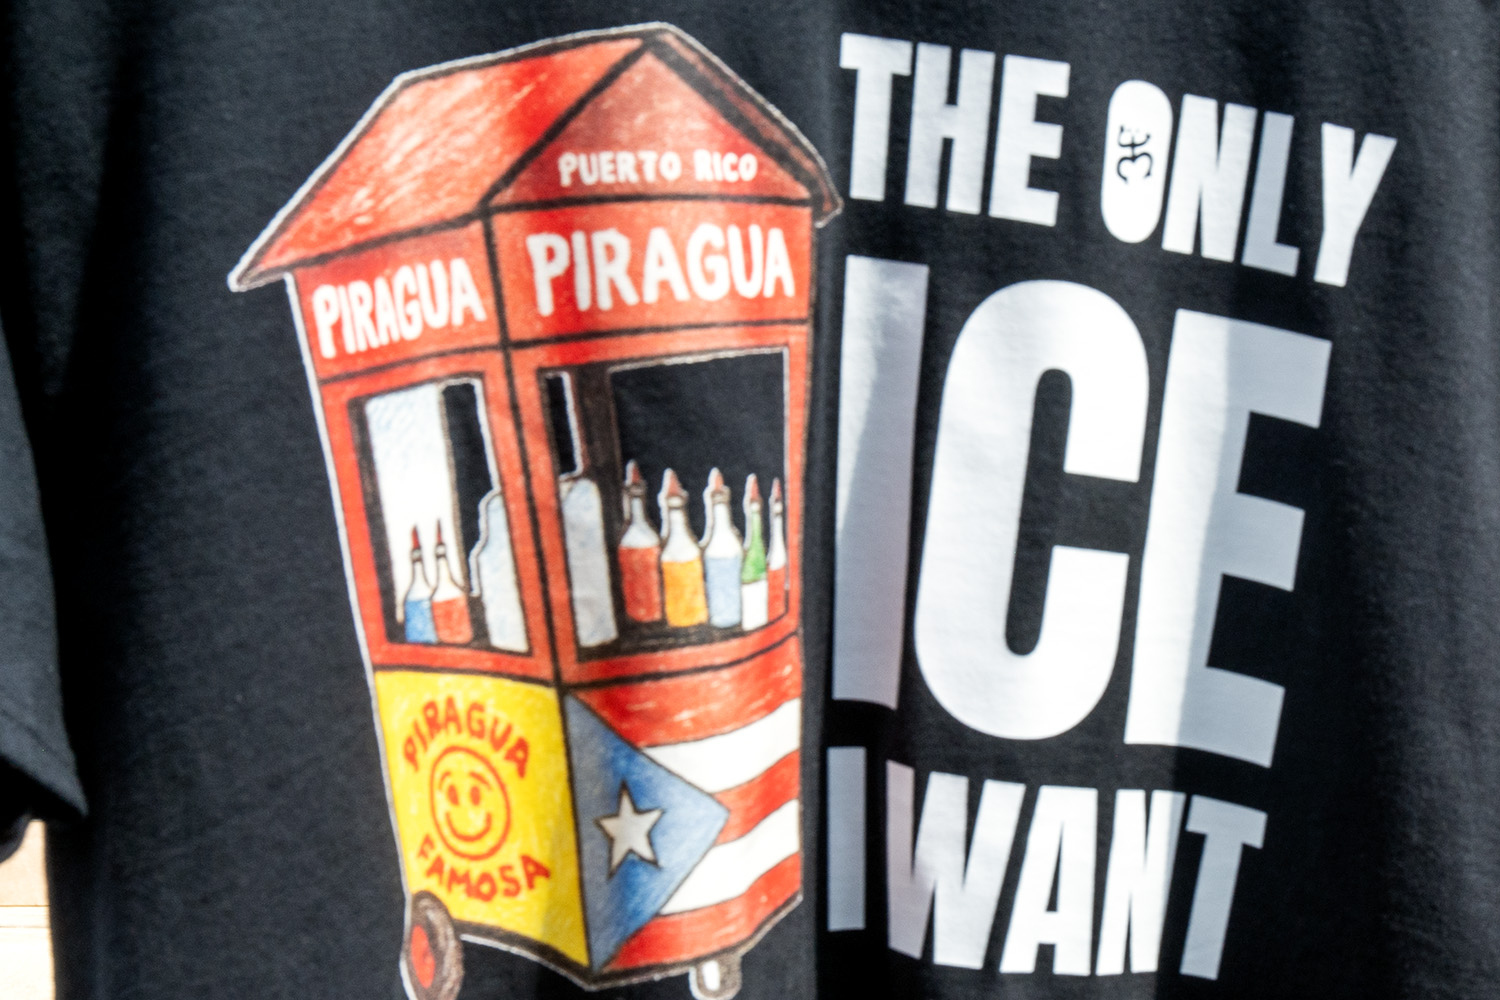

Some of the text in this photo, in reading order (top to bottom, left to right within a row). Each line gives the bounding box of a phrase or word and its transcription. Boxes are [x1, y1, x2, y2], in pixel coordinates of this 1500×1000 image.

[558, 149, 759, 187] PUERTO RICO
[840, 33, 1397, 287] THE ONLY
[312, 258, 487, 360] PIRAGUA
[526, 223, 795, 317] PIRAGUA
[832, 254, 1332, 769] ICE
[403, 697, 531, 778] PIRAGUA
[416, 836, 551, 902] FAMOSA
[827, 746, 1268, 980] I WANT
